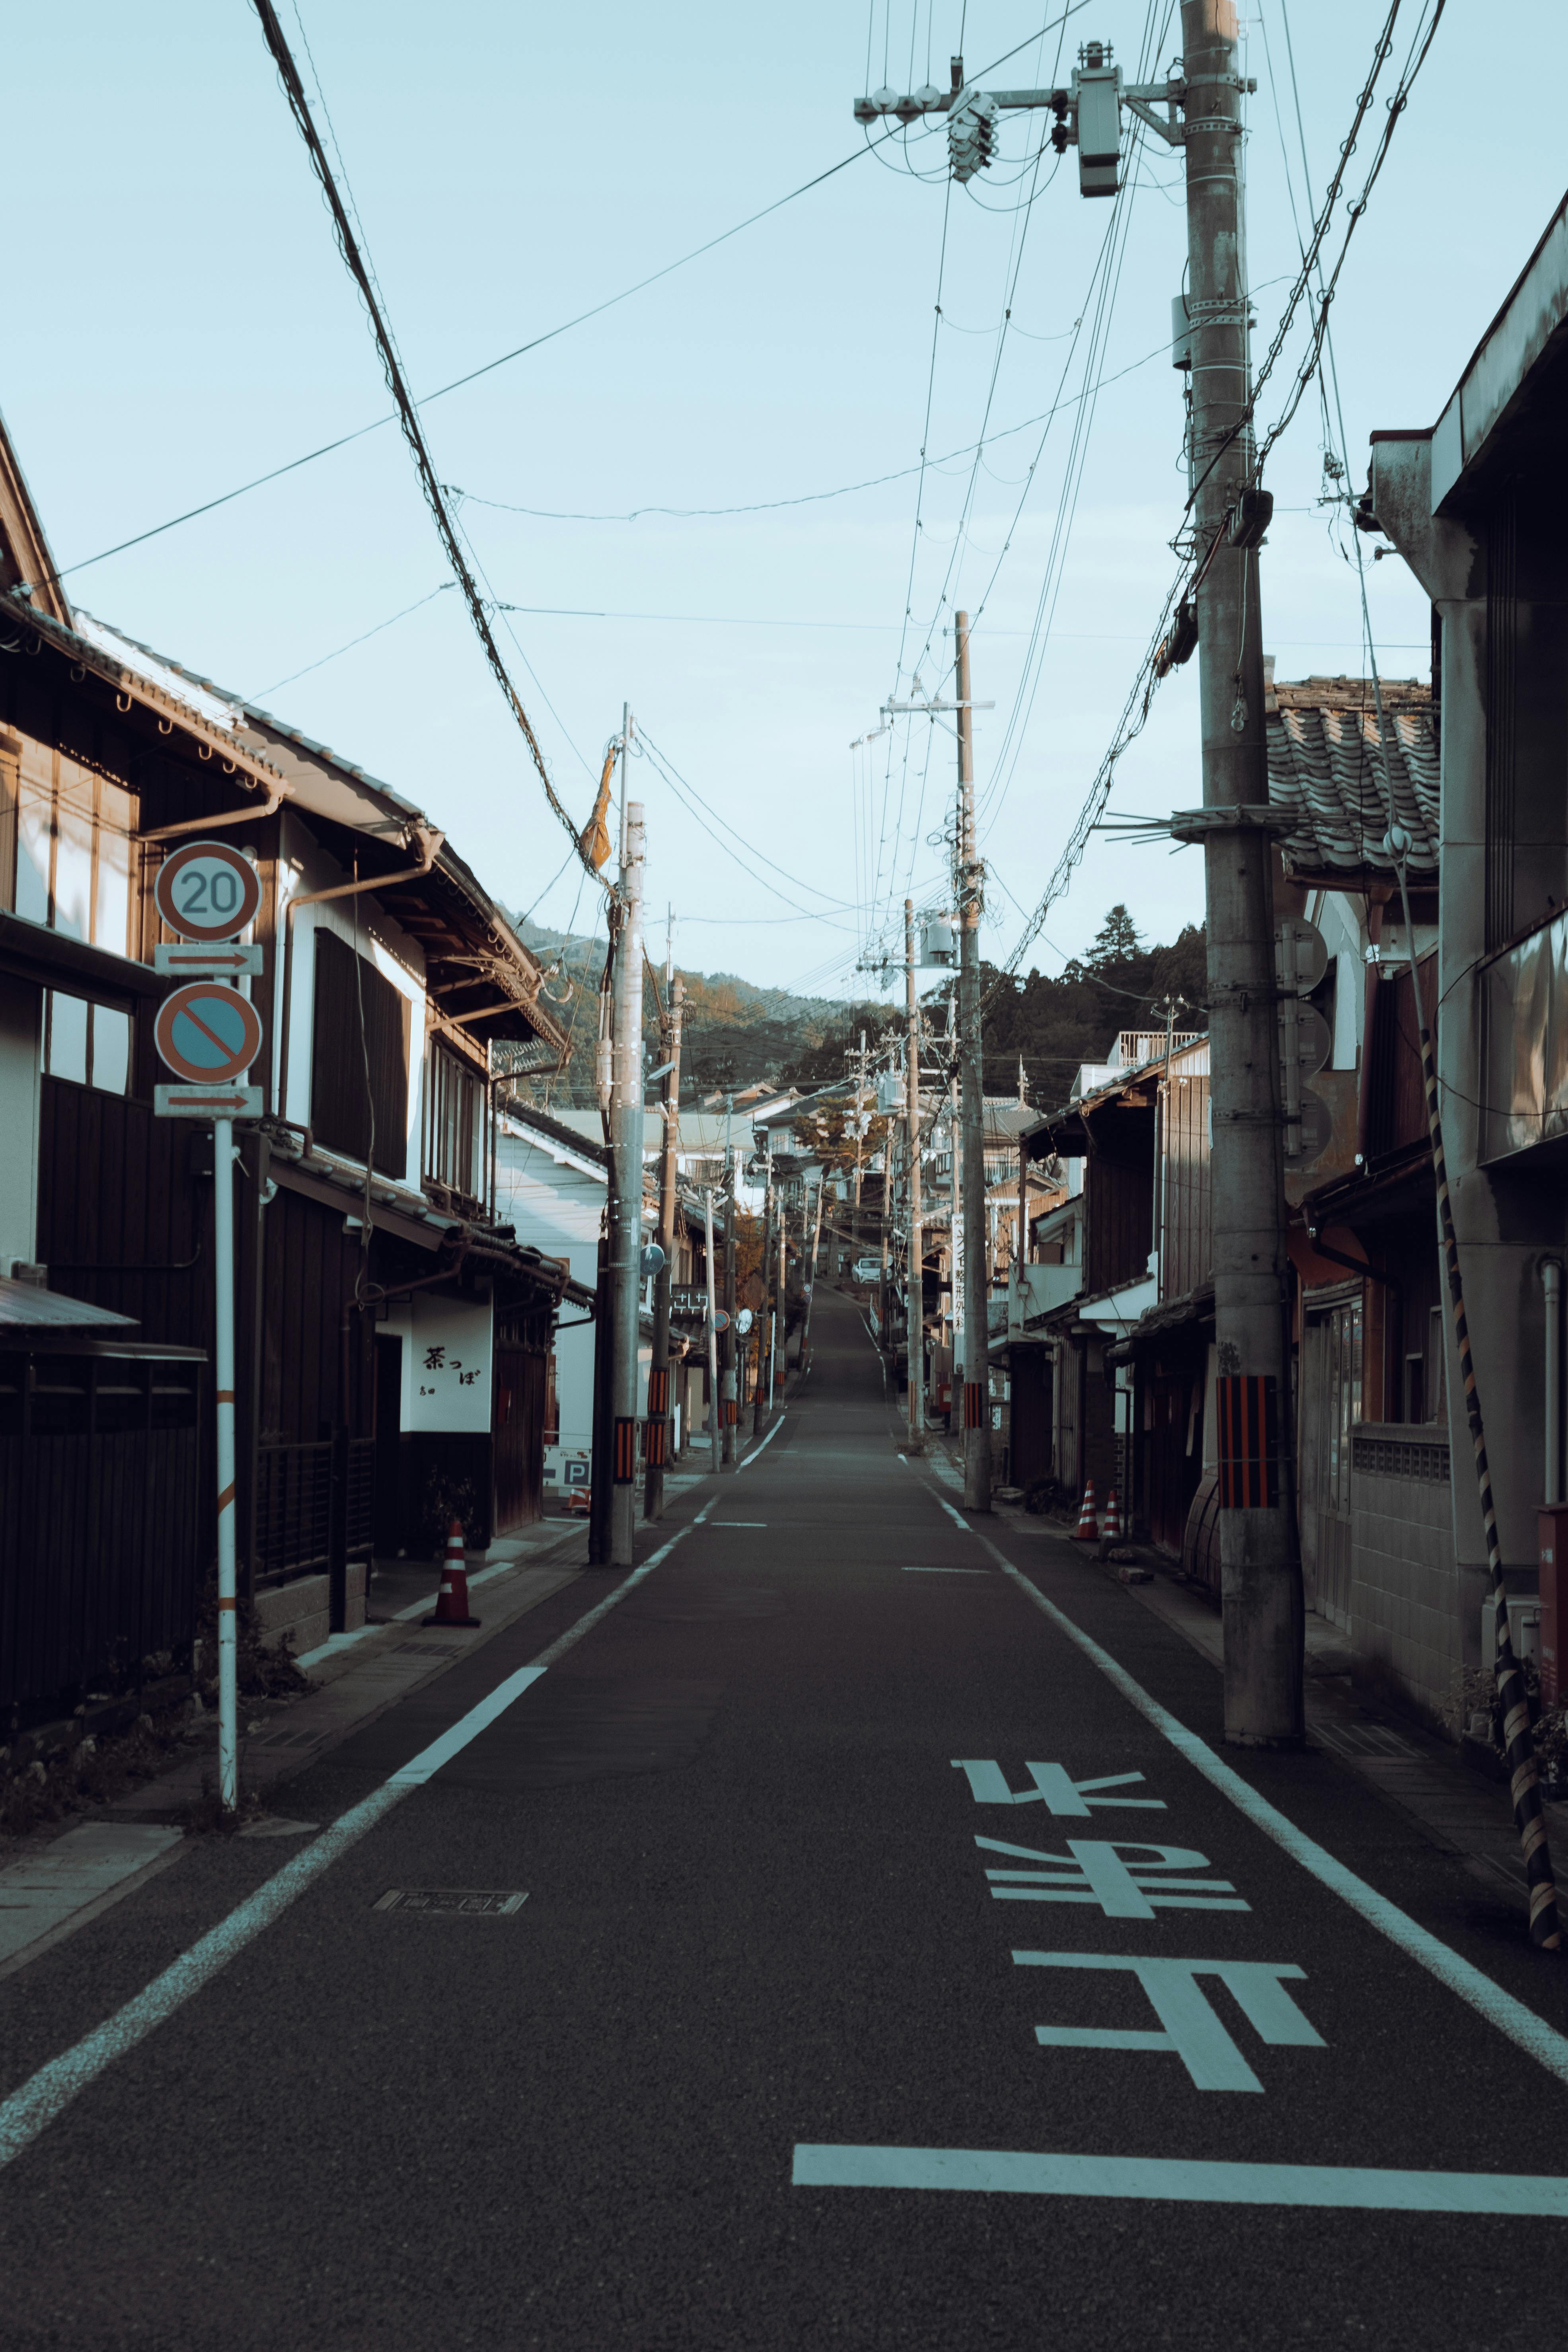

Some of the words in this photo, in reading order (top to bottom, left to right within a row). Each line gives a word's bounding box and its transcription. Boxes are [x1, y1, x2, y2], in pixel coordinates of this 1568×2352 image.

[181, 871, 237, 914] 20
[570, 1464, 585, 1483] P
[950, 1760, 1329, 2093] 止まれ
